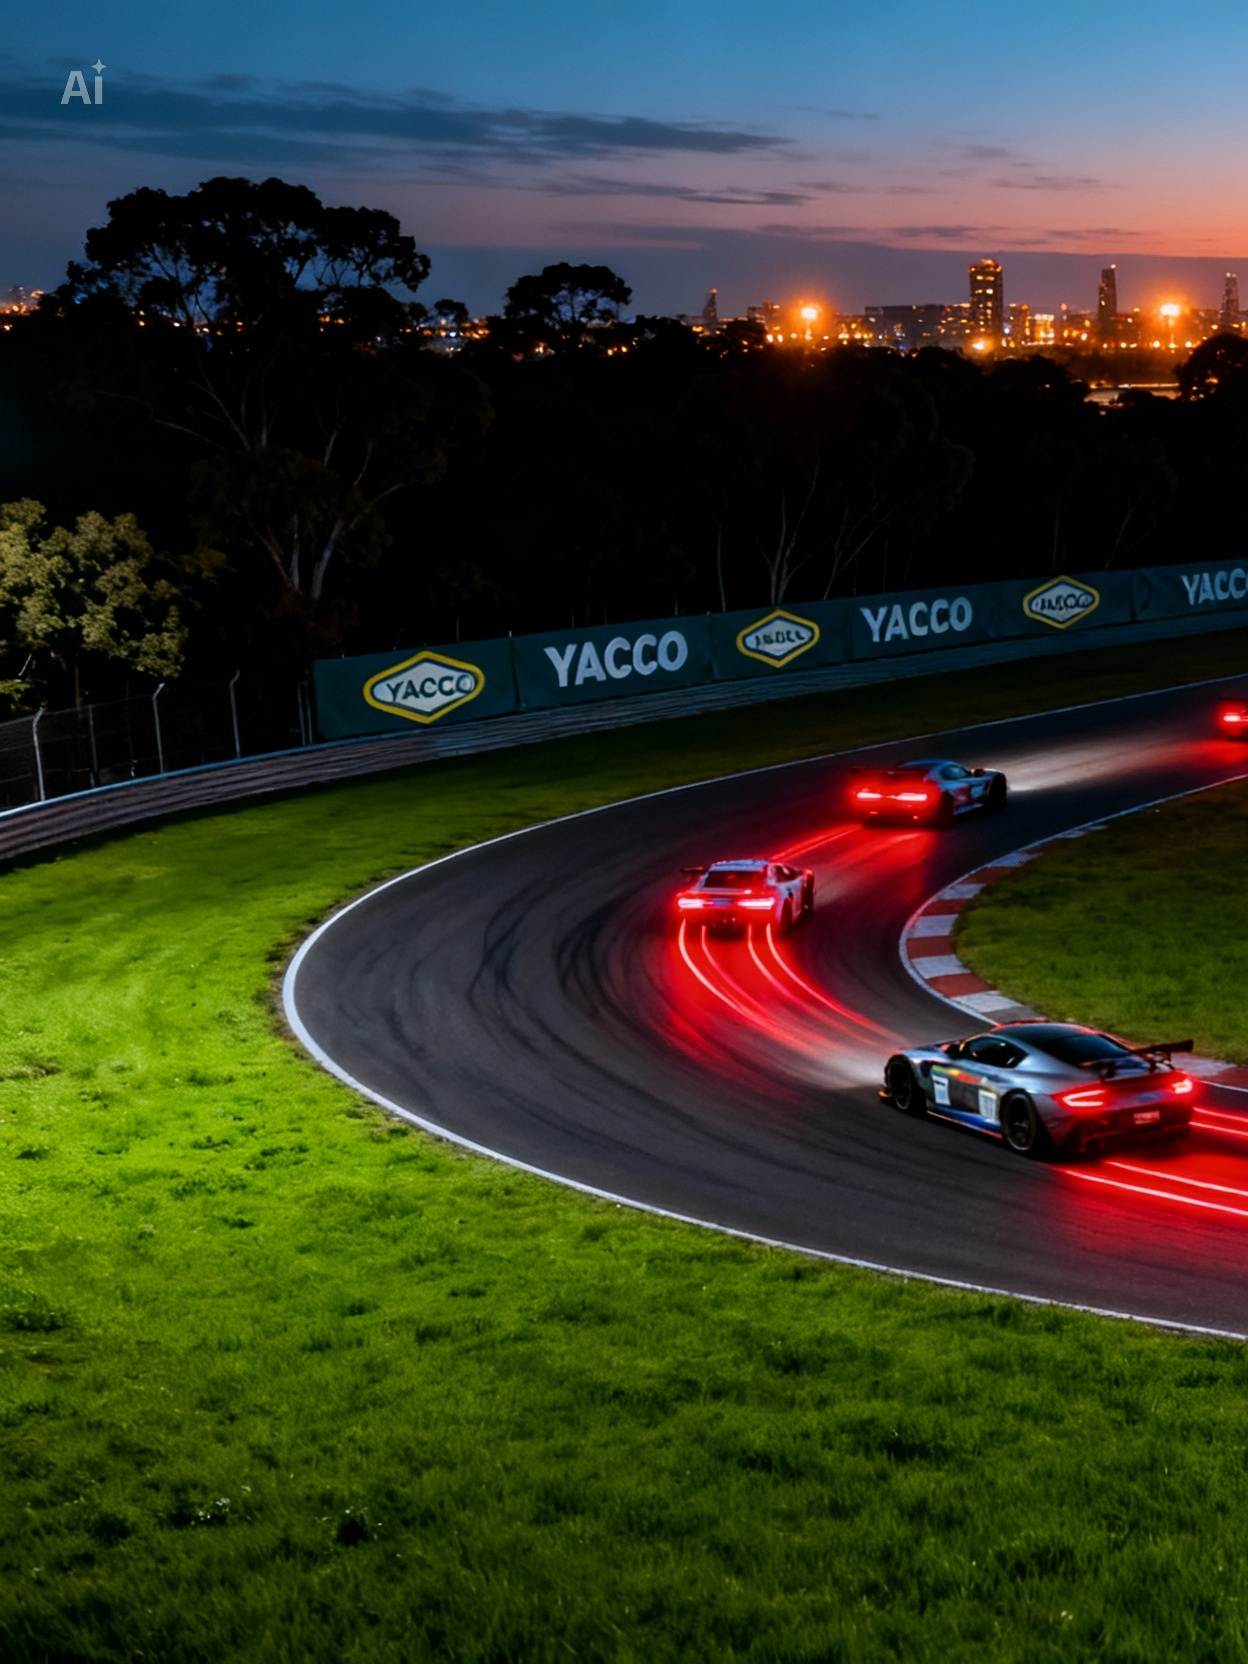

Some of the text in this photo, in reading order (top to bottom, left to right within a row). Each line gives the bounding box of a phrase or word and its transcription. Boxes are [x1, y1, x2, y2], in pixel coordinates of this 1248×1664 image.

[860, 597, 972, 643] YACCO
[543, 630, 689, 688] YACCO
[386, 674, 472, 702] YACCO
